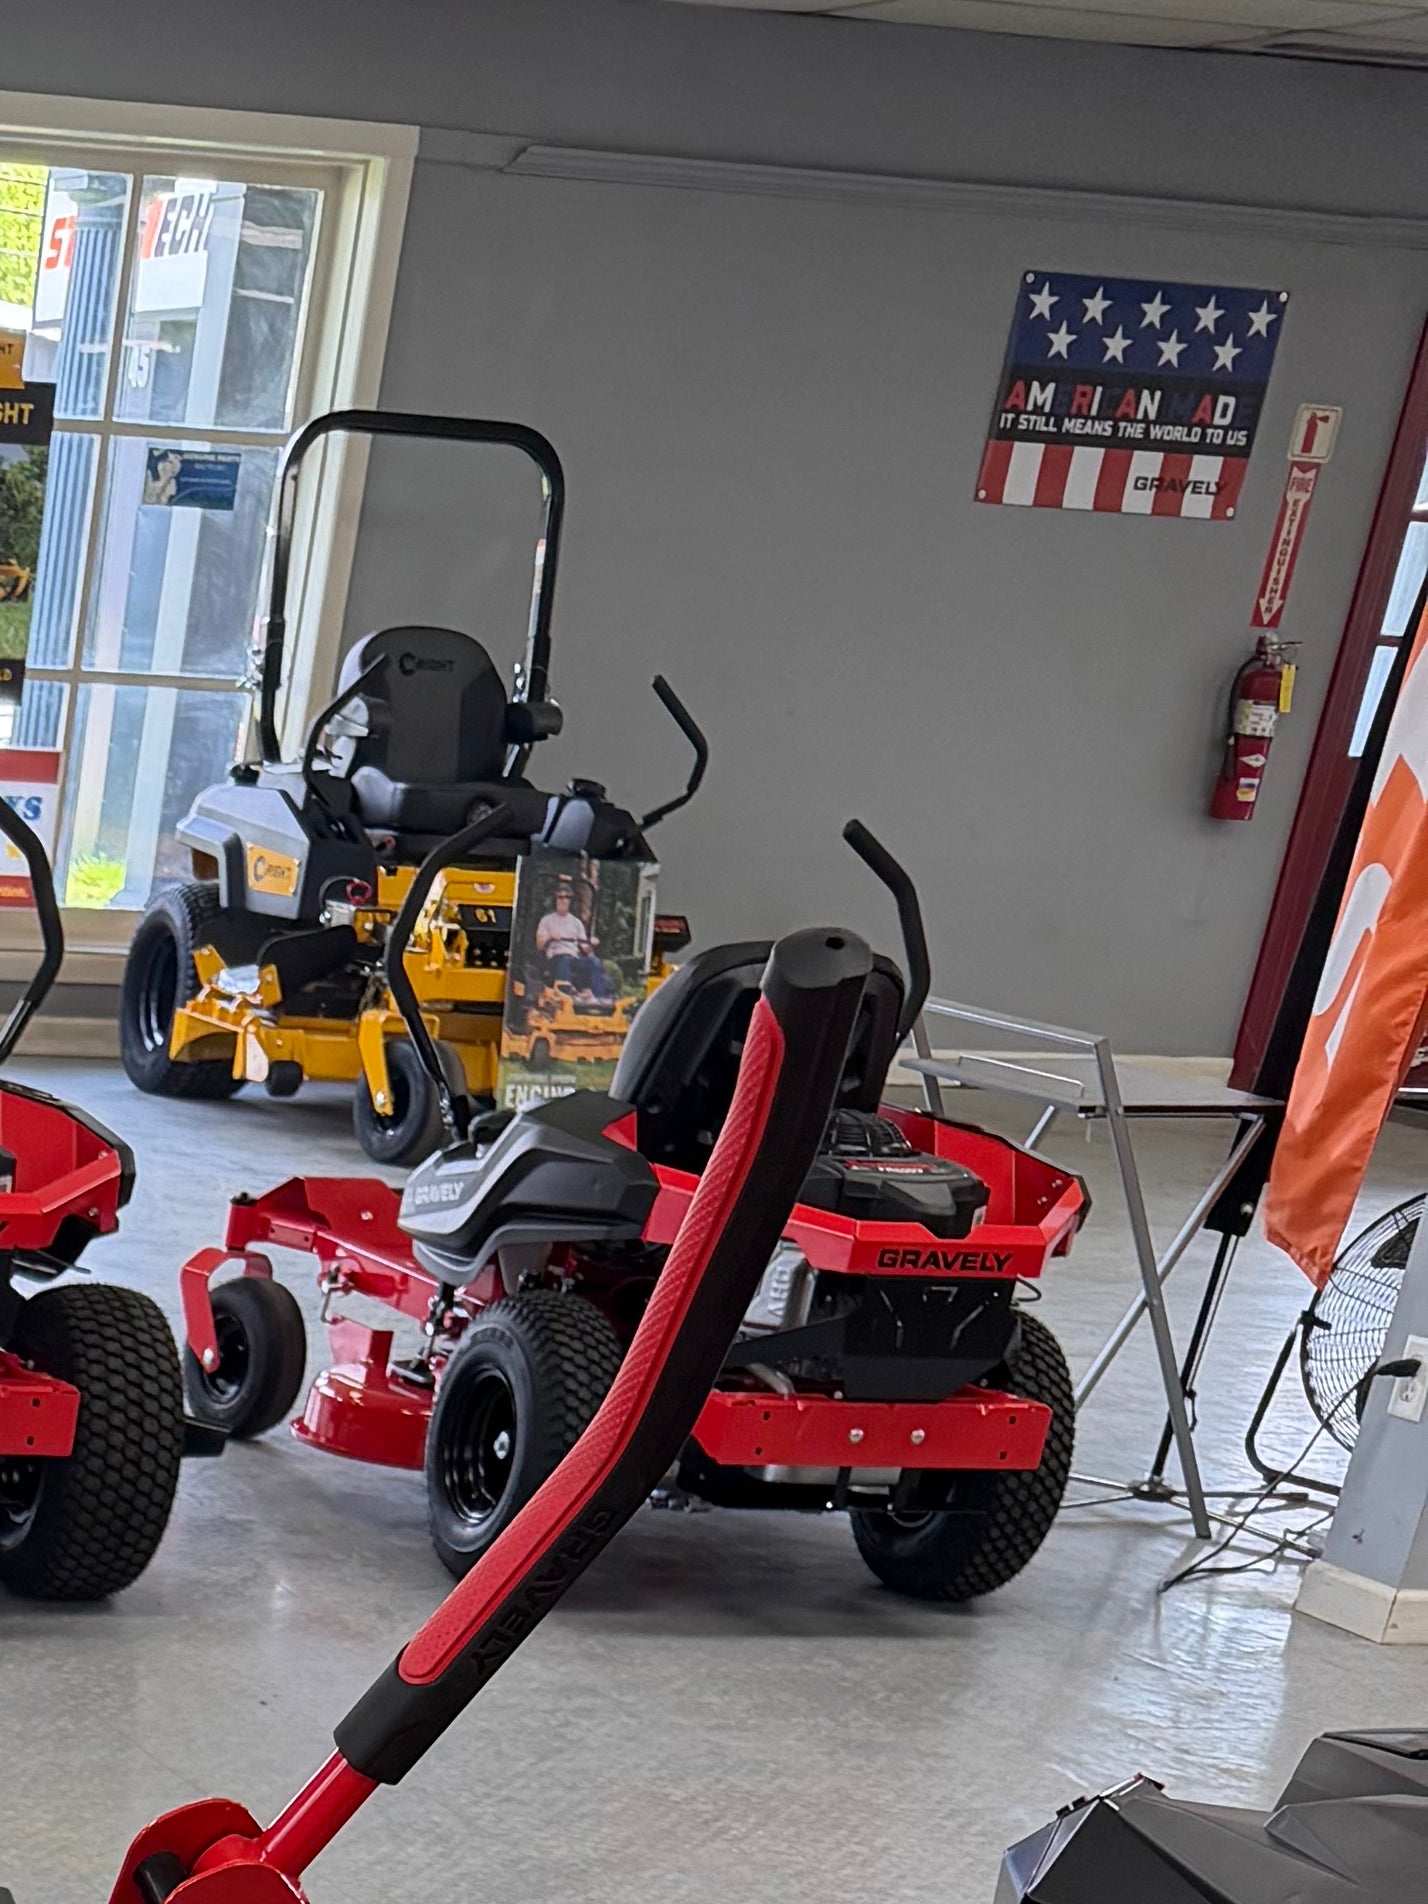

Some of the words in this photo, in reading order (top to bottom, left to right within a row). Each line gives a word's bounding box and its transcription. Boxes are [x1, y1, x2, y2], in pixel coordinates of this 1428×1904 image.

[999, 412, 1016, 430] IT
[1018, 413, 1057, 433] STILL
[1061, 417, 1114, 437] MEANS
[1116, 421, 1146, 440] THE
[1149, 424, 1201, 443] WORLD
[1204, 427, 1223, 445] TO
[1226, 429, 1248, 447] US
[1132, 475, 1229, 497] GRAVELY
[877, 1248, 1013, 1272] GRAVELY
